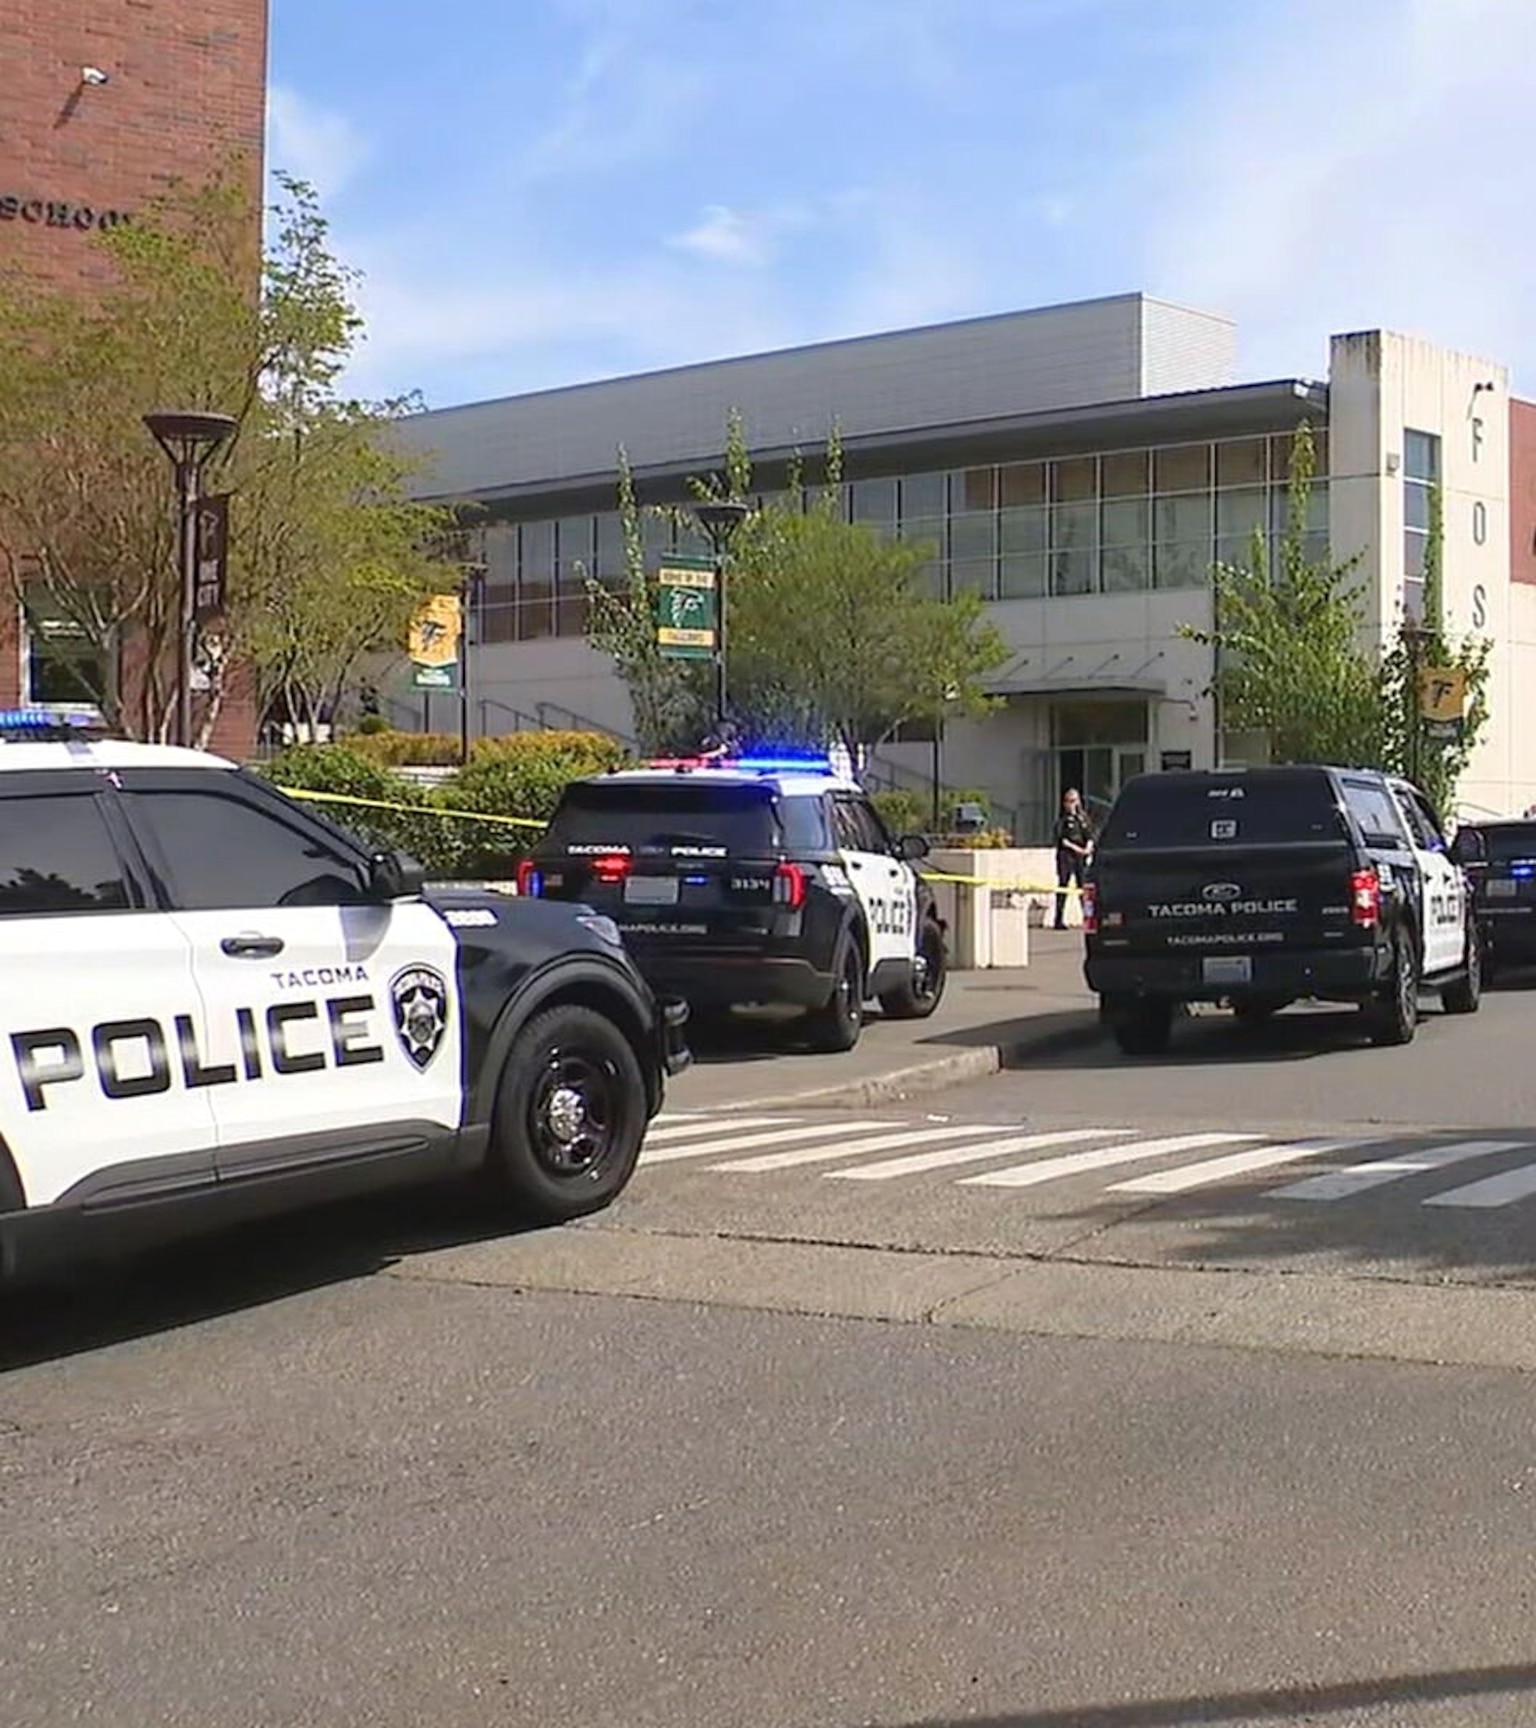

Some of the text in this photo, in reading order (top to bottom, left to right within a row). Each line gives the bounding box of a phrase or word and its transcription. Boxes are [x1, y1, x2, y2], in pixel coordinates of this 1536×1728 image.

[567, 845, 631, 855] TACOMA
[671, 847, 727, 857] POLICE
[1149, 899, 1298, 917] TACOMA POLICE
[271, 965, 369, 989] TACOMA
[10, 994, 384, 1112] POLICE
